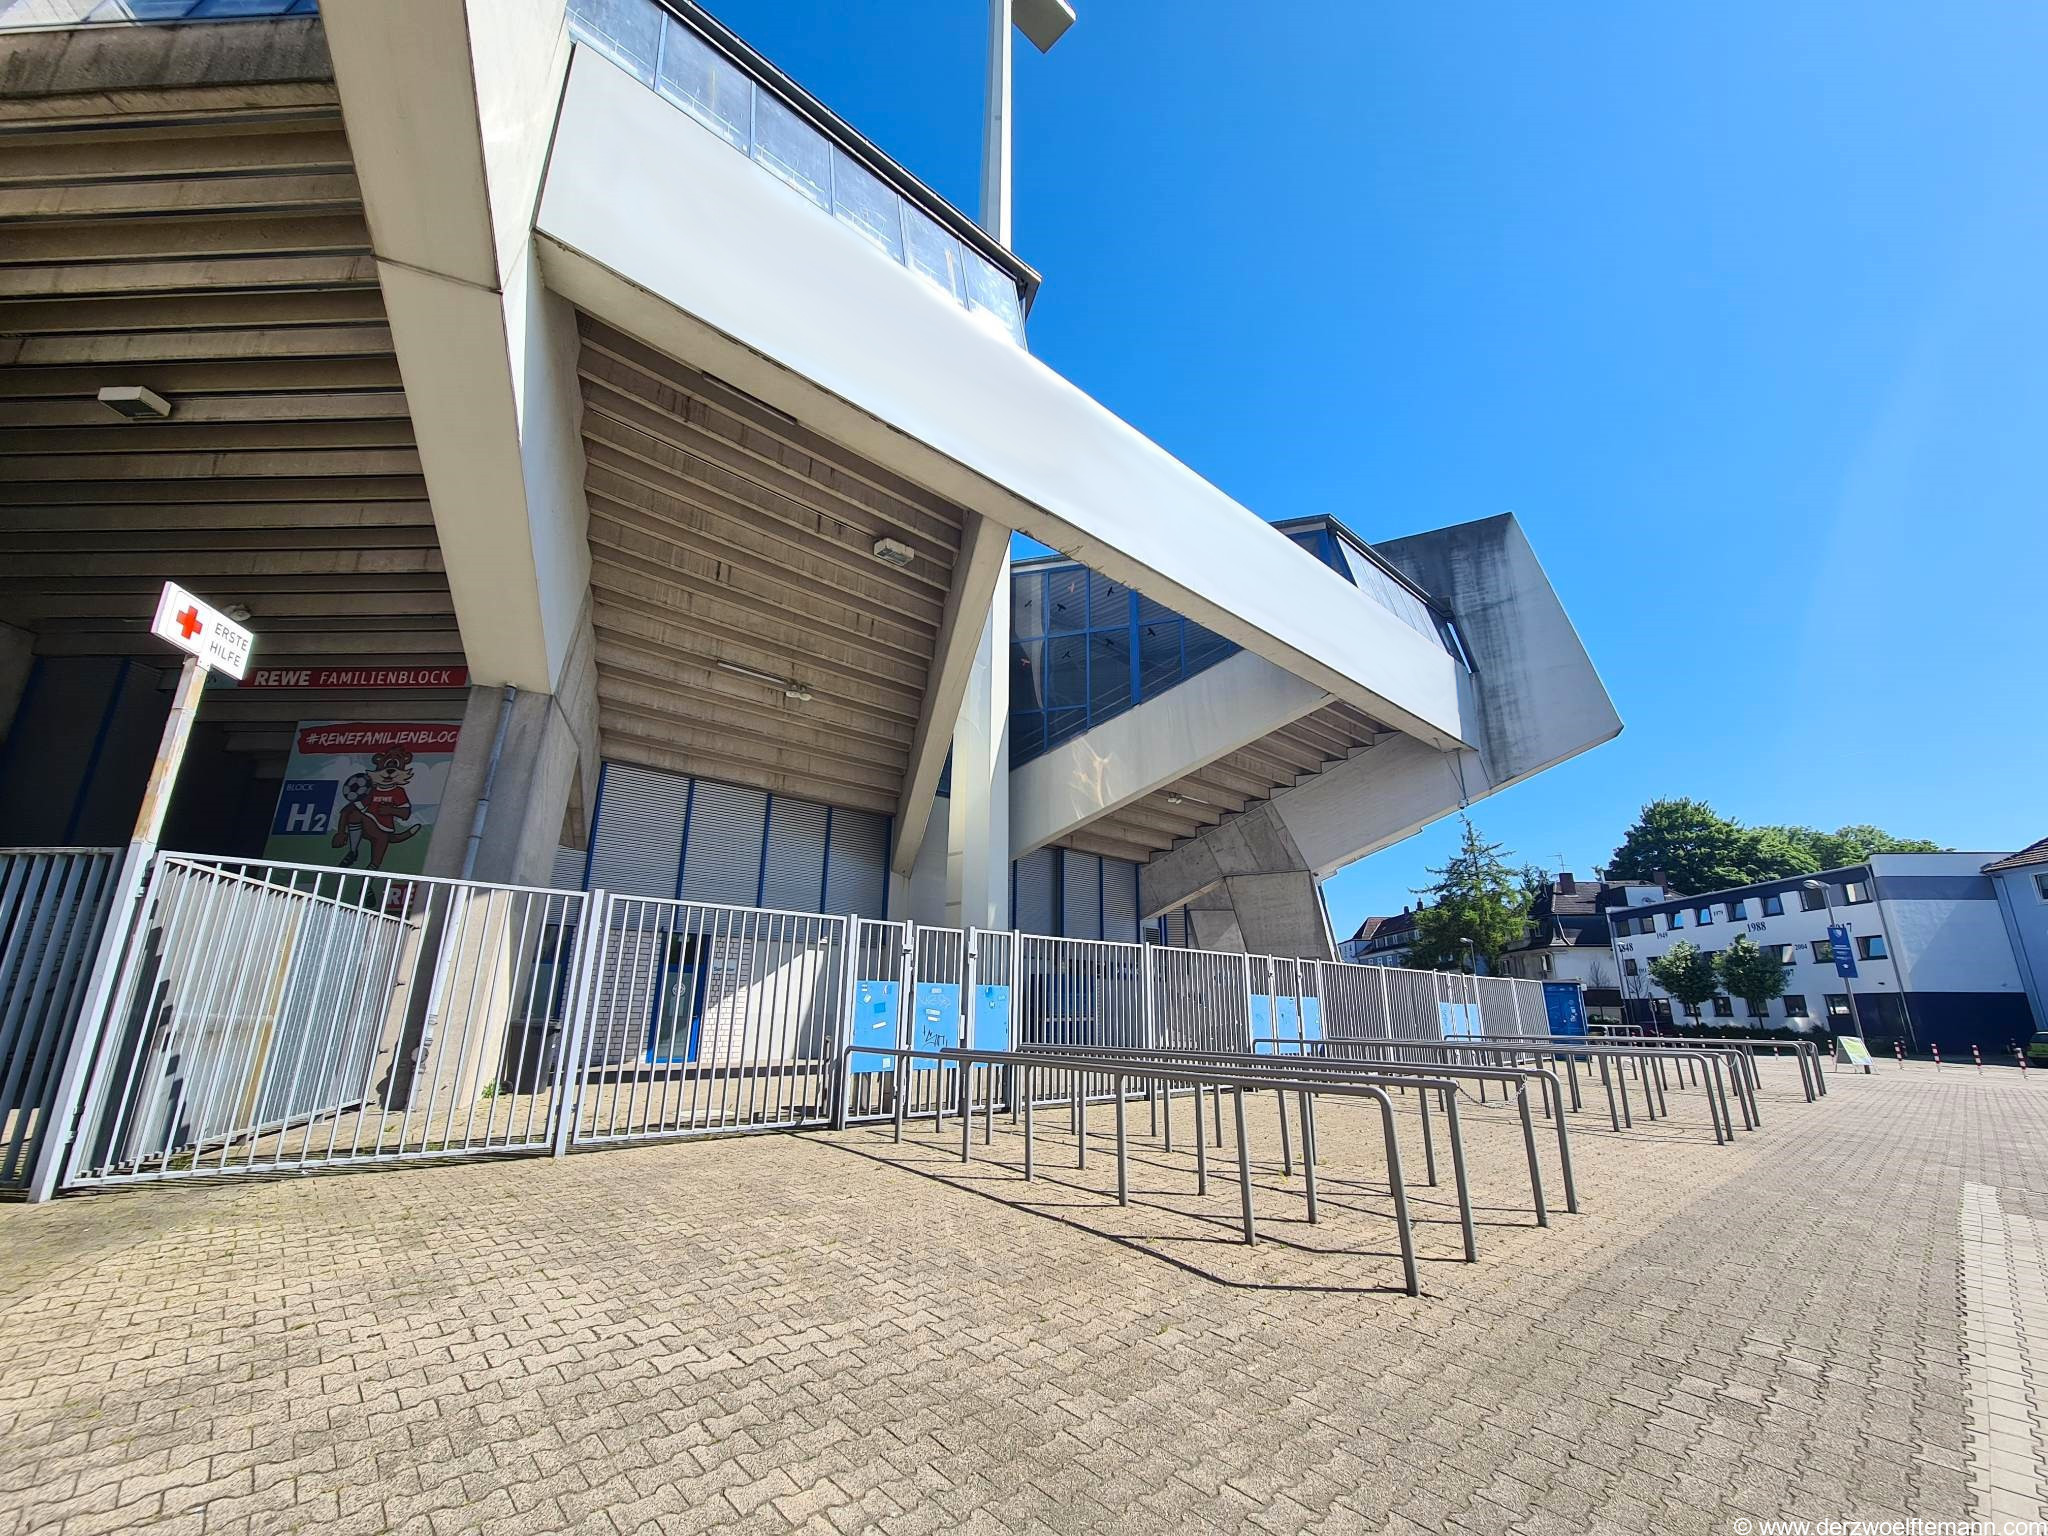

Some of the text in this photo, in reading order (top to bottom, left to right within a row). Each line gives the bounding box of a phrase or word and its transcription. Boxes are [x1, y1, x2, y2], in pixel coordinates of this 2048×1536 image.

[214, 622, 249, 652] ERSTE
[209, 641, 241, 667] HILFE
[254, 670, 451, 686] REWE FAMILIENBLOCK
[306, 731, 459, 746] #REWEFAMILIENBLOC
[286, 783, 315, 792] BLOCK
[285, 803, 327, 832] H2
[1746, 921, 1767, 933] 1988
[1795, 943, 1808, 951] 2004
